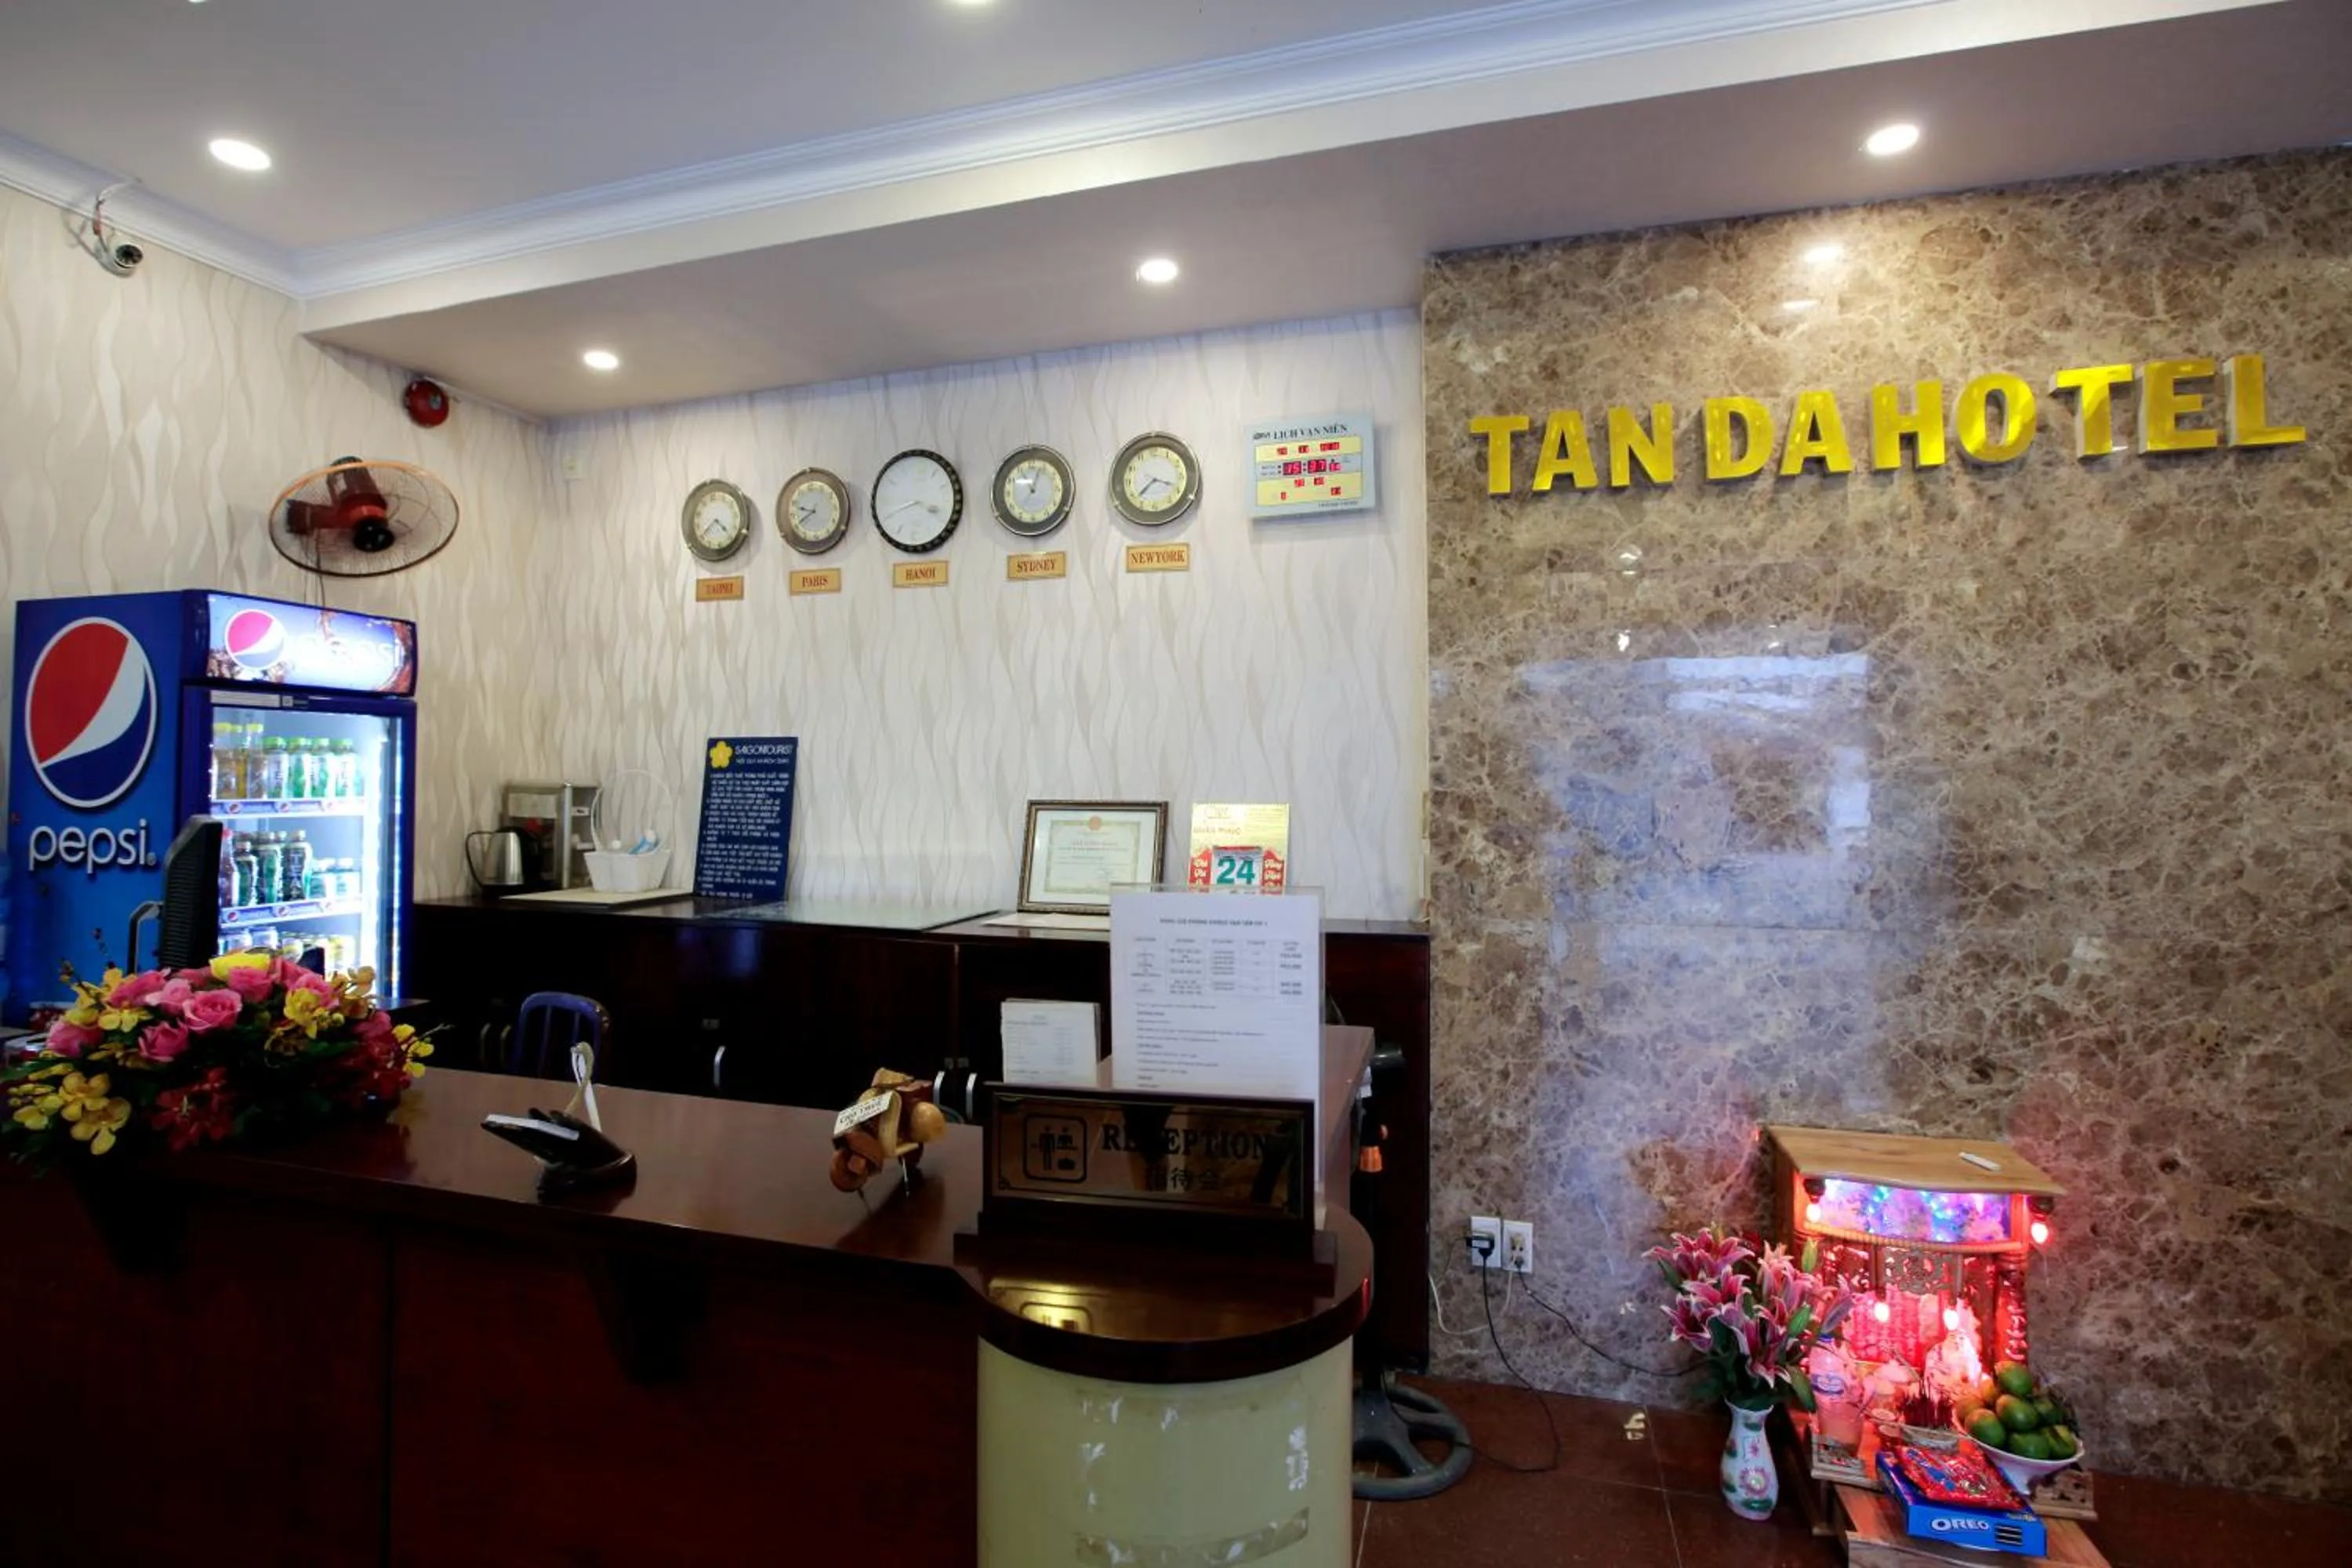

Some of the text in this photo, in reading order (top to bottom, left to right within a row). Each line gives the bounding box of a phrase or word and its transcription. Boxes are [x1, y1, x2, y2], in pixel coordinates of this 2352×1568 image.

[1468, 401, 1675, 494] TAN
[906, 568, 936, 581] HANOI
[1017, 558, 1056, 572] SYDNEY
[28, 818, 148, 874] pepsi
[1216, 858, 1256, 885] 24
[1102, 1123, 1272, 1160] REEPTION
[1931, 1518, 1990, 1531] OREO
